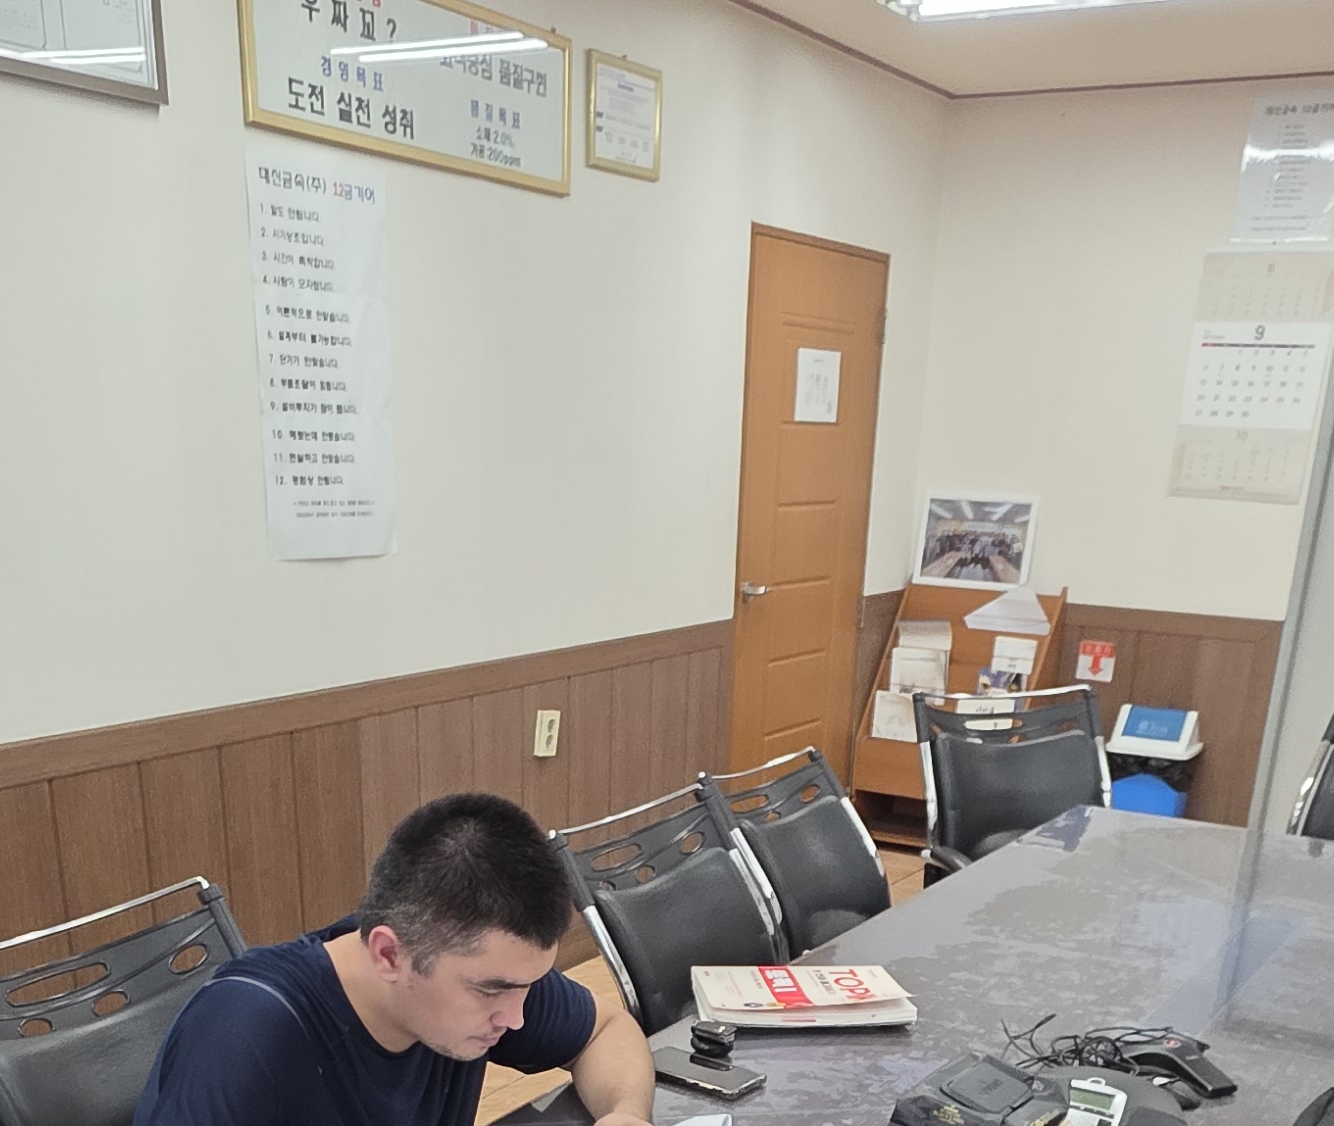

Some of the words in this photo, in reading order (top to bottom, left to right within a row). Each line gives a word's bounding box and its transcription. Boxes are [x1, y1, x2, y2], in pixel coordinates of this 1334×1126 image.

[288, 76, 325, 116] 도전
[337, 91, 371, 129] 실전
[382, 104, 414, 140] 성취
[258, 167, 327, 195] 대신금속(주)
[1254, 325, 1265, 340] 9
